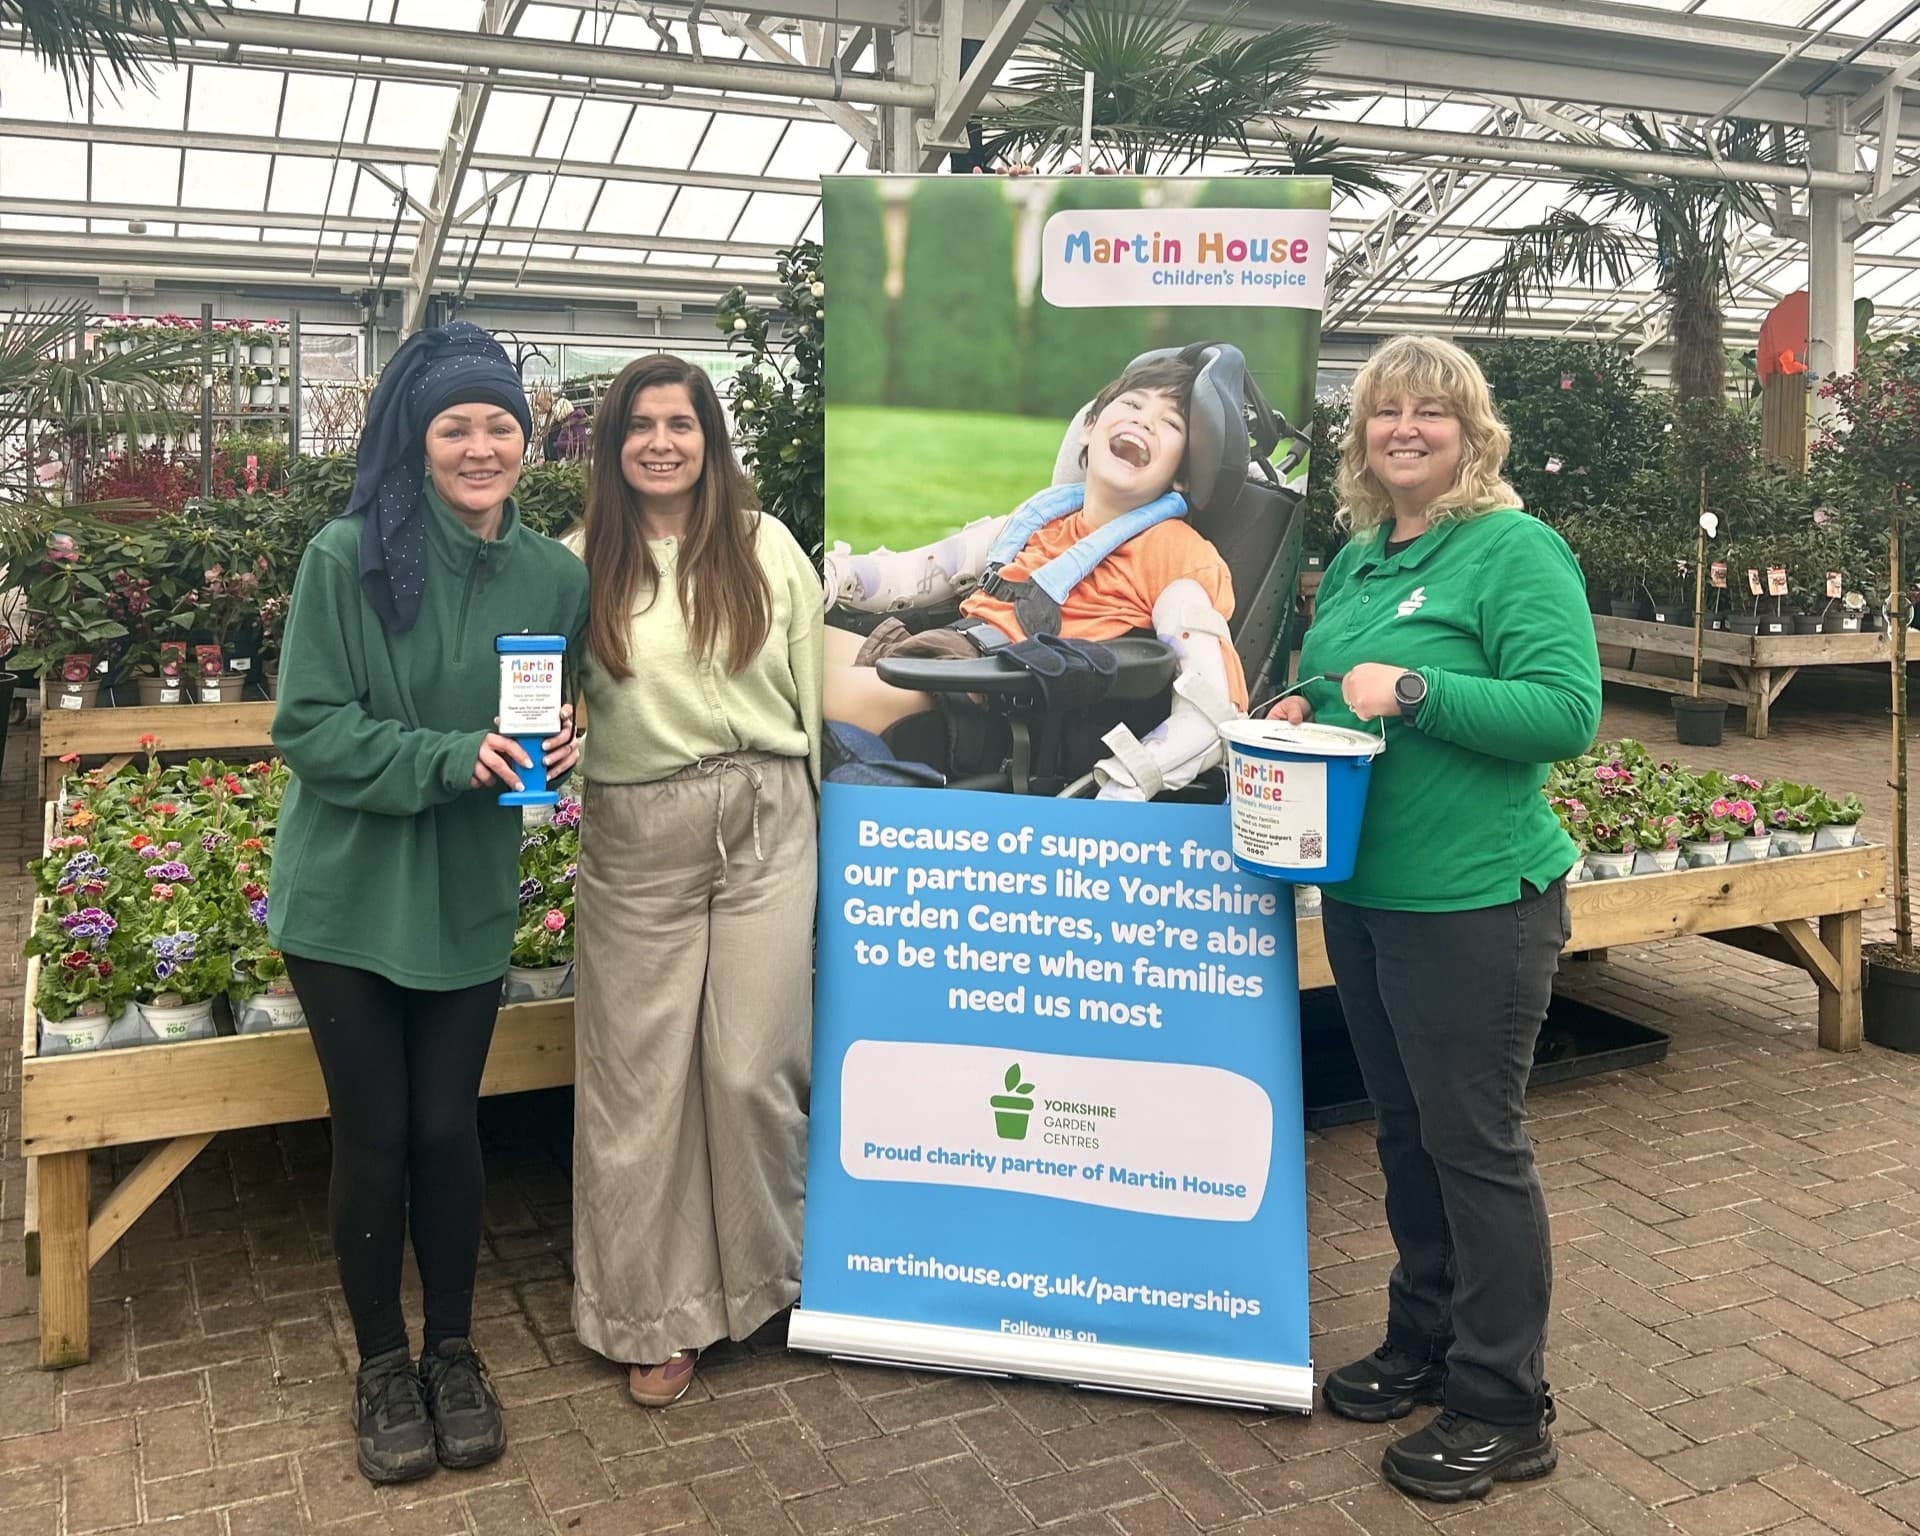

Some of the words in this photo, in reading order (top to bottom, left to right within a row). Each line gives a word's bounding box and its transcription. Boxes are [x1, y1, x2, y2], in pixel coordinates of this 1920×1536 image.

[1064, 230, 1182, 265] Martin
[1197, 231, 1309, 265] House
[1151, 269, 1234, 286] Children's
[1241, 270, 1306, 289] Hospice
[511, 659, 554, 671] Martin
[513, 672, 552, 683] House
[1235, 756, 1284, 784] Martin
[1236, 775, 1282, 801] House
[859, 820, 989, 853] Because
[997, 827, 1033, 854] of
[1041, 835, 1171, 868] support
[1180, 840, 1240, 873] fro
[844, 863, 898, 887] our
[906, 865, 1047, 896] partners
[1055, 868, 1110, 901] like
[1118, 876, 1276, 916] Yorkshire
[843, 898, 959, 930] Garden
[968, 904, 1103, 945] Centres,
[1111, 919, 1198, 951] we're
[1207, 926, 1276, 957] able
[855, 939, 889, 966] to
[897, 938, 936, 969] be
[943, 942, 1031, 975] there
[1038, 951, 1123, 984] when
[1131, 958, 1263, 998] families
[948, 985, 1026, 1014] need
[1034, 994, 1071, 1018] us
[1079, 998, 1162, 1029] most
[1043, 1099, 1117, 1120] YORKSHIRE
[1043, 1116, 1096, 1132] GARDEN
[1043, 1132, 1100, 1150] CENTRES
[863, 1142, 922, 1163] Proud
[926, 1147, 997, 1173] charity
[1001, 1154, 1077, 1178] partner
[1081, 1163, 1105, 1181] of
[1108, 1166, 1177, 1191] Martin
[1182, 1175, 1247, 1198] House
[847, 1253, 1261, 1319] martinhouse.org.uk/partnerships
[1000, 1319, 1050, 1337] Follow
[1055, 1328, 1073, 1340] us
[1077, 1331, 1097, 1343] on
